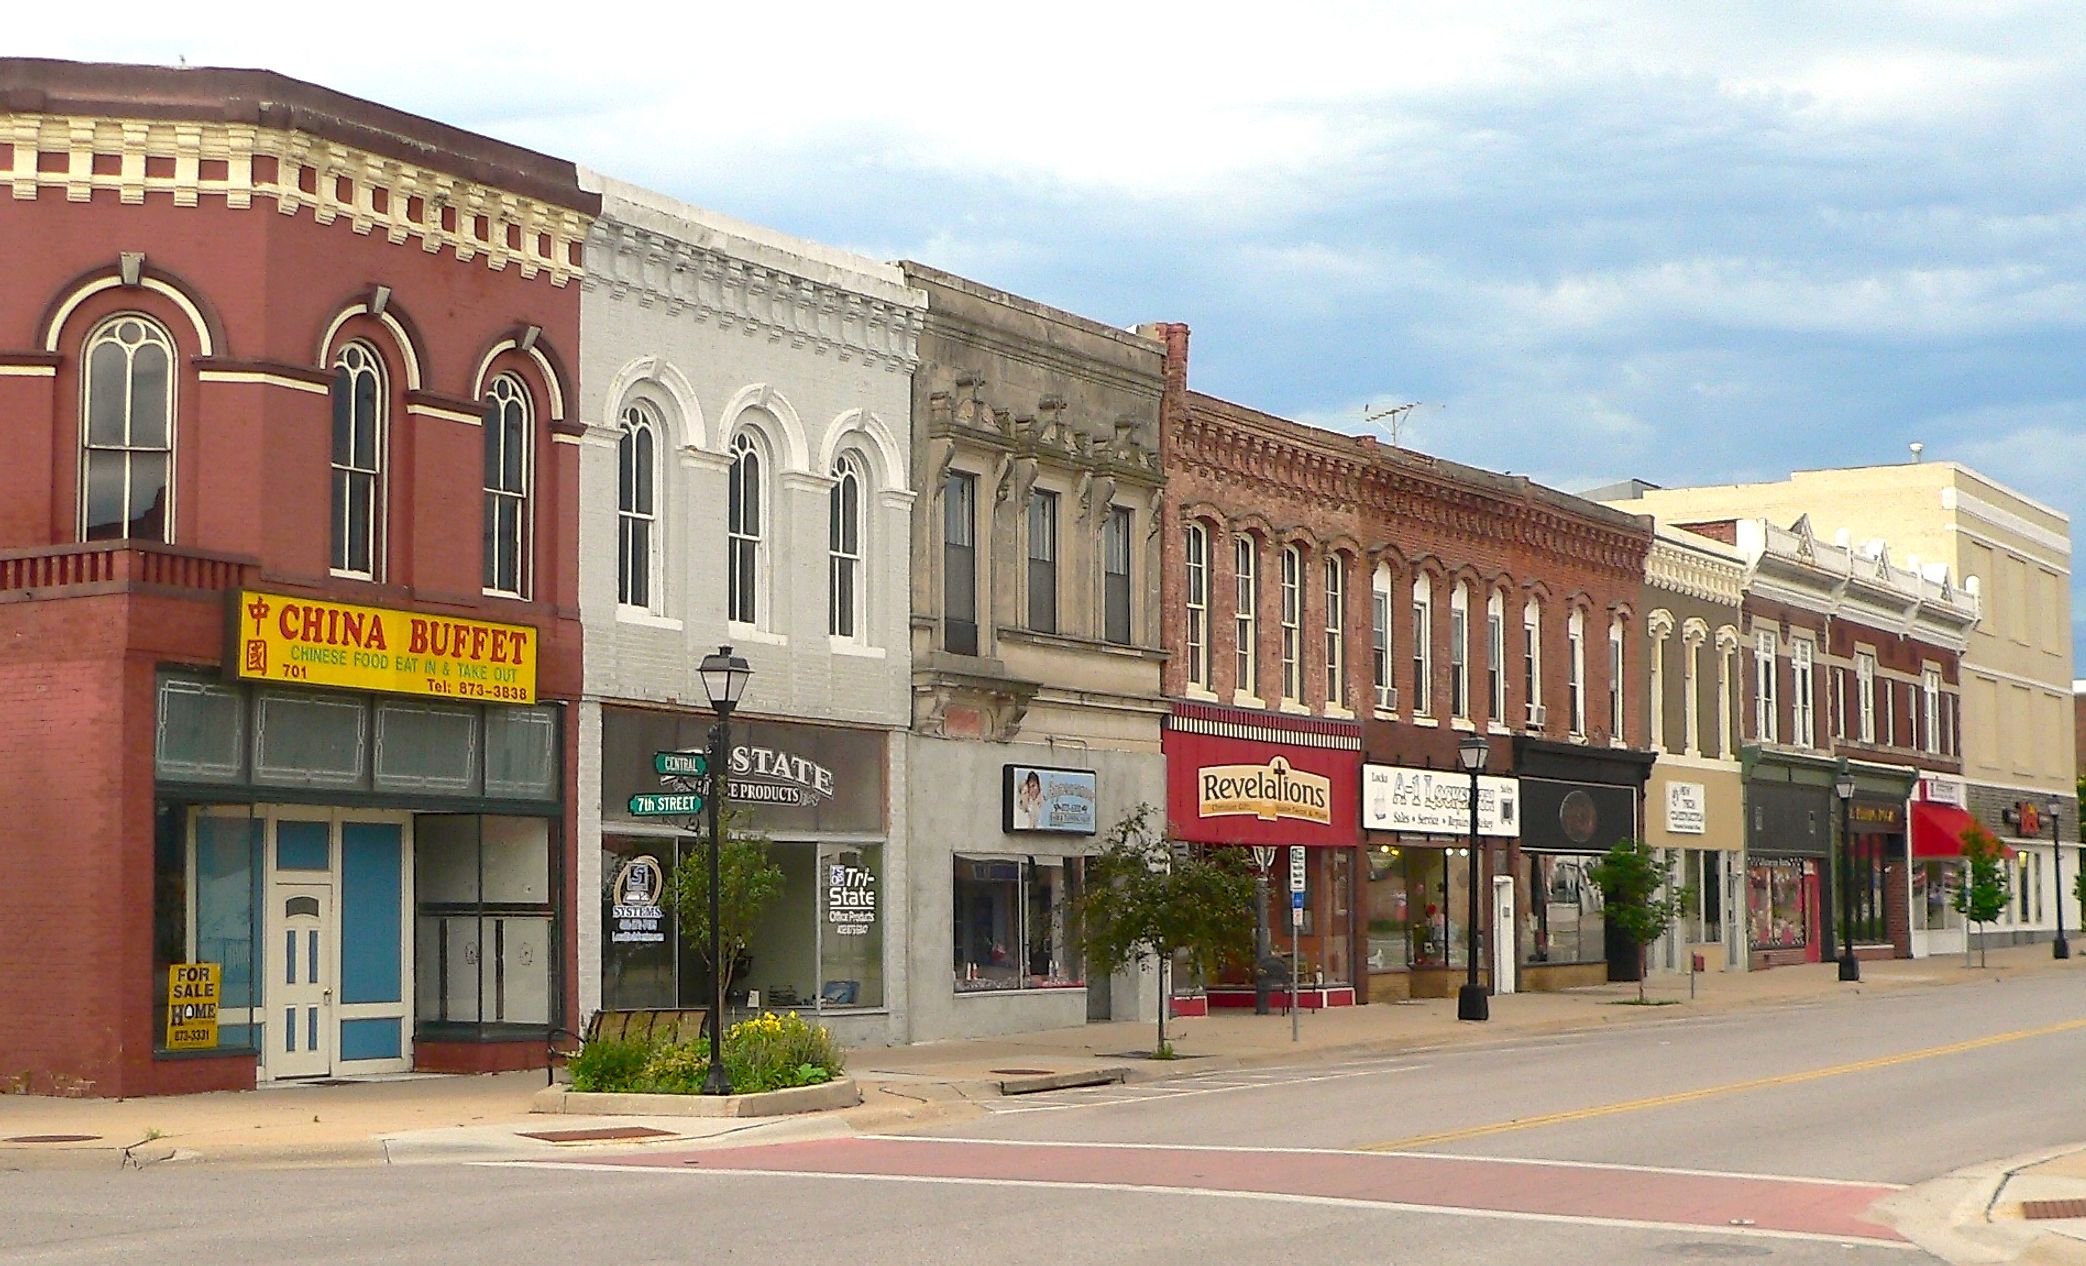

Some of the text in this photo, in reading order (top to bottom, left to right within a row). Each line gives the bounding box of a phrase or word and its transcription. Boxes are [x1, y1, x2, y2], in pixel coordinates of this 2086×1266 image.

[279, 603, 527, 664] CHINA BUFFET
[283, 664, 307, 679] 701
[291, 645, 518, 682] CHINESE FOOD EAT IN & TAKE OUT
[427, 679, 527, 700] Tel: 873-3838
[665, 757, 698, 773] CENTRAL
[739, 782, 799, 803] PRODUCTS
[1203, 760, 1325, 808] Revelations
[1393, 772, 1421, 806] A-1
[638, 796, 695, 811] 7th STREET
[845, 867, 875, 887] Tri-
[829, 887, 875, 906] State
[613, 906, 662, 918] SYSTEMS
[178, 967, 210, 982] FOR
[173, 983, 215, 999] SALE
[171, 1003, 216, 1026] HOME
